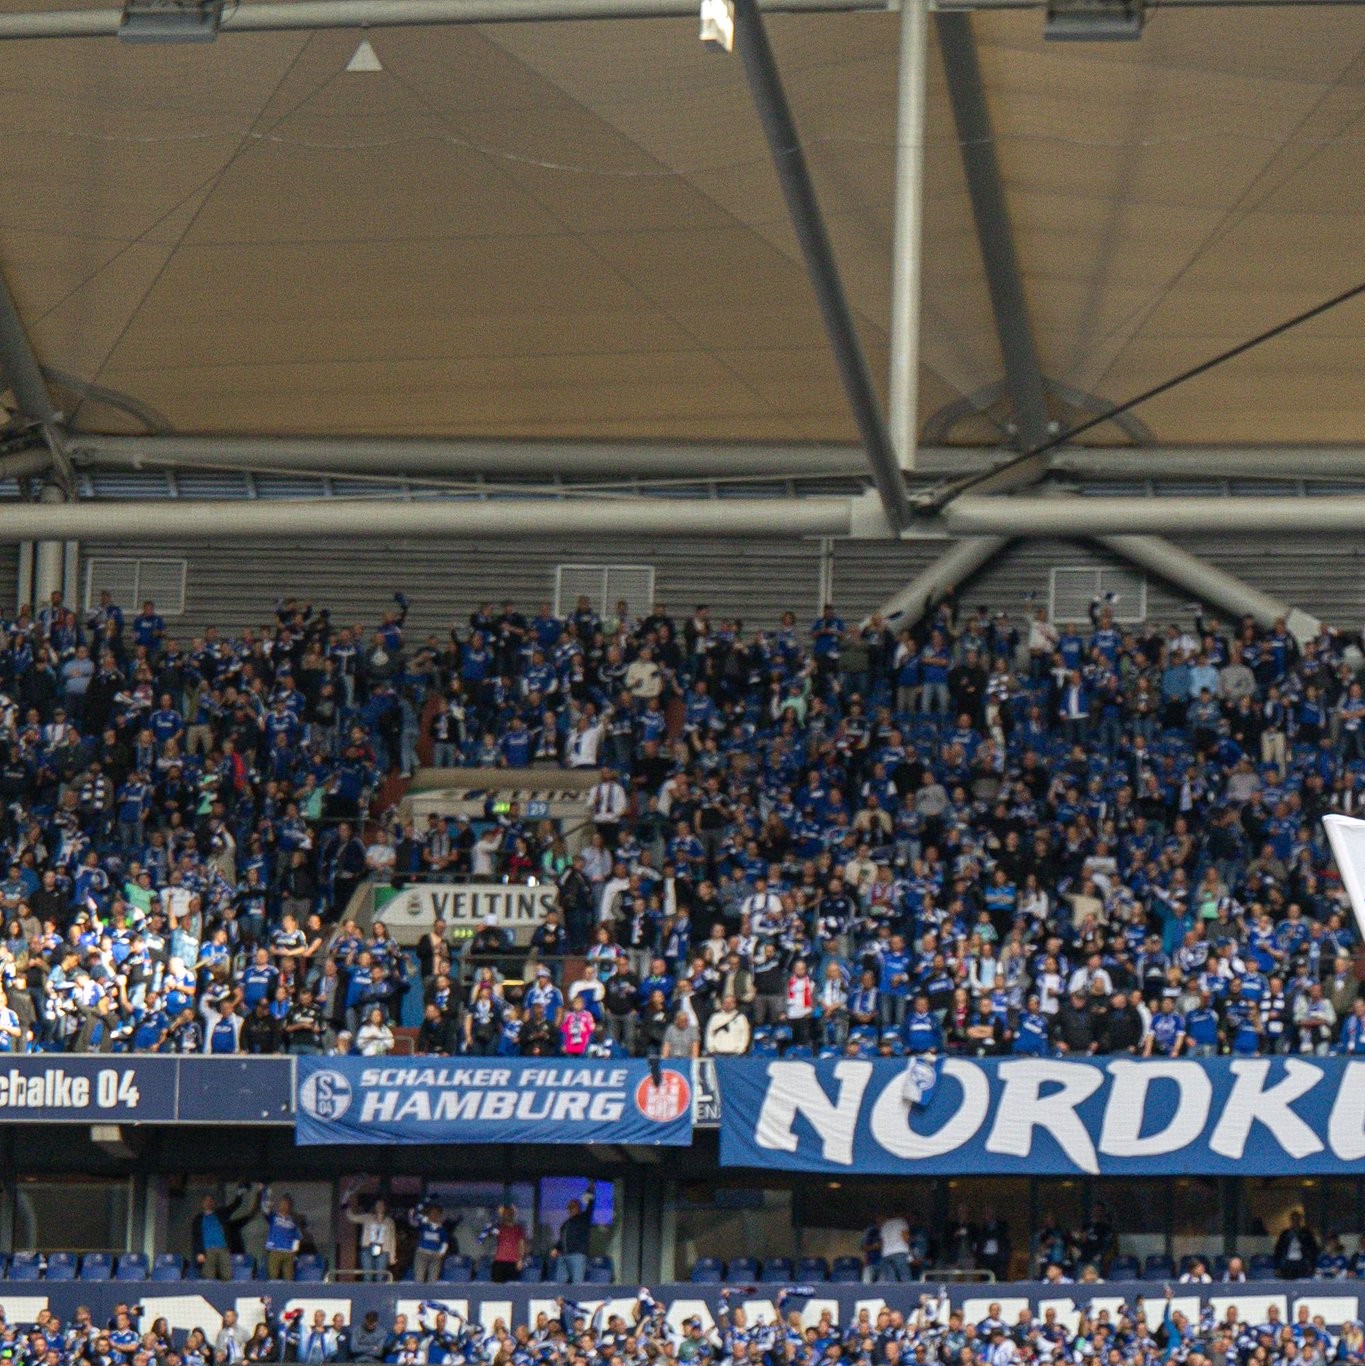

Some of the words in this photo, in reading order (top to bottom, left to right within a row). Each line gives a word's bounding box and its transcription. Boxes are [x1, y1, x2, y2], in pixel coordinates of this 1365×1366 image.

[431, 892, 554, 920] VELTINS
[98, 1068, 140, 1108] 04
[360, 1069, 512, 1087] SCHALKER
[519, 1069, 628, 1087] FILIALE
[360, 1091, 627, 1122] HAMBURG
